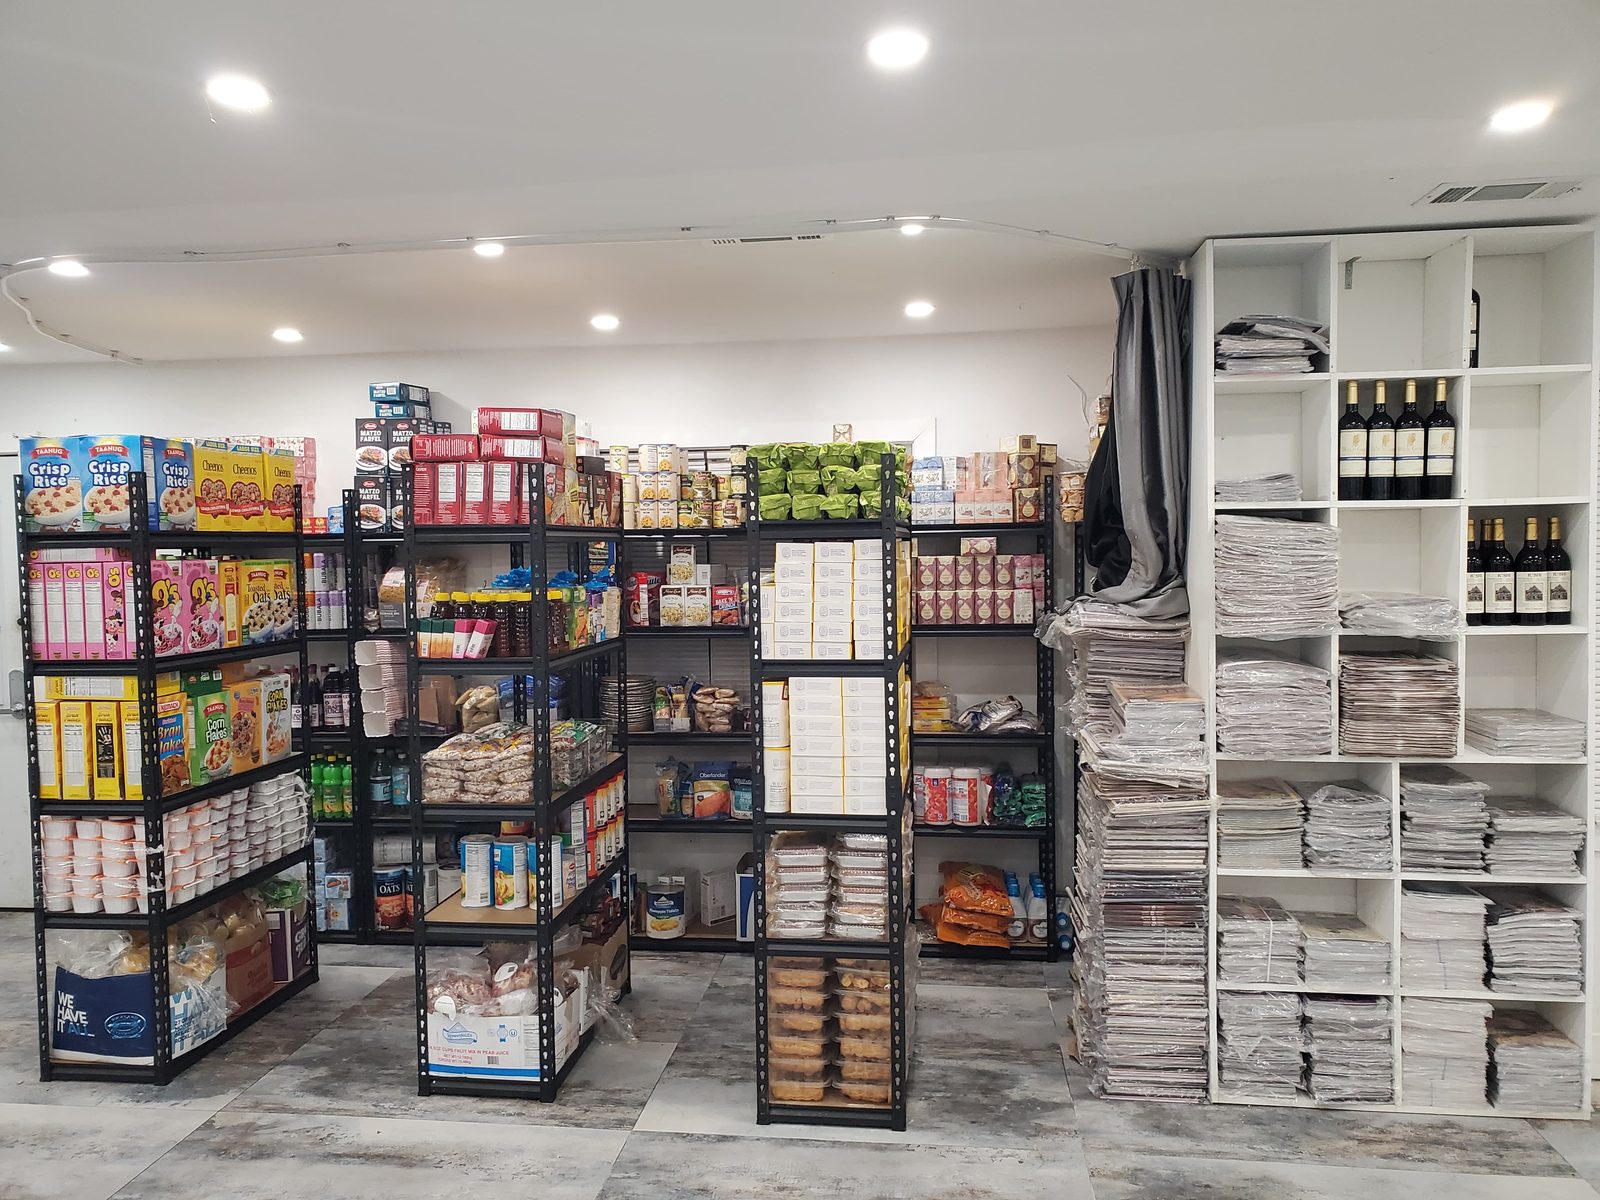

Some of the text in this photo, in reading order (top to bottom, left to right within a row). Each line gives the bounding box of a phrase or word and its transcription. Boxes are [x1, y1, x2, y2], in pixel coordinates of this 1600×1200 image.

[29, 462, 70, 477] Crisp
[88, 460, 131, 476] Crisp
[163, 462, 189, 479] Crisp
[34, 475, 68, 487] Rice
[93, 473, 128, 486] Rice
[166, 475, 188, 487] Rice
[48, 567, 61, 579] O's
[67, 567, 80, 578] O's
[86, 567, 100, 578] O's
[246, 584, 266, 593] Toasted
[252, 590, 271, 604] Oats
[207, 704, 224, 712] TAANUG
[207, 718, 225, 731] Corn
[158, 725, 181, 739] Bran
[206, 728, 228, 743] Flakes
[160, 738, 185, 753] lakes
[380, 885, 400, 894] OATS
[58, 990, 74, 1009] WE
[57, 1005, 88, 1024] HAVE
[57, 1018, 65, 1033] IT
